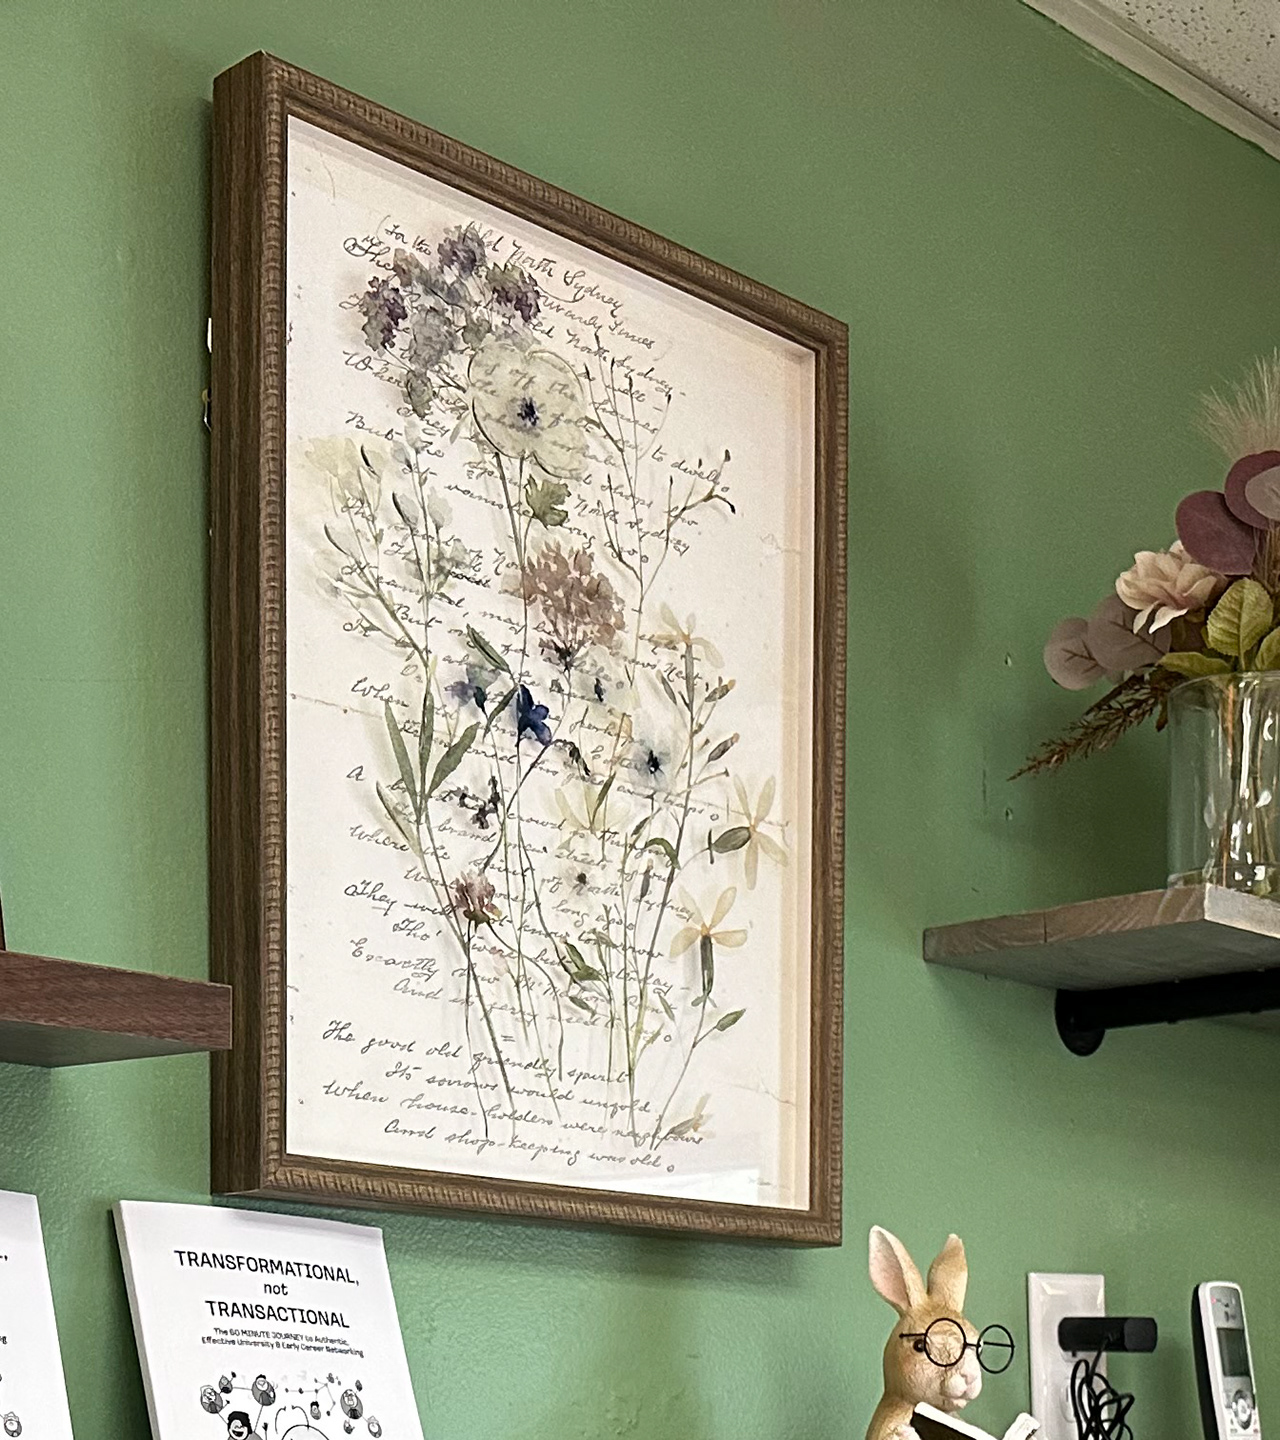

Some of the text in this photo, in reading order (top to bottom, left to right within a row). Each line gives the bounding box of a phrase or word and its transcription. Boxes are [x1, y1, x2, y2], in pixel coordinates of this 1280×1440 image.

[173, 1250, 360, 1287] TRANSFORMATIONAL,
[263, 1282, 289, 1296] not
[204, 1300, 350, 1328] TRANSACTIONAL
